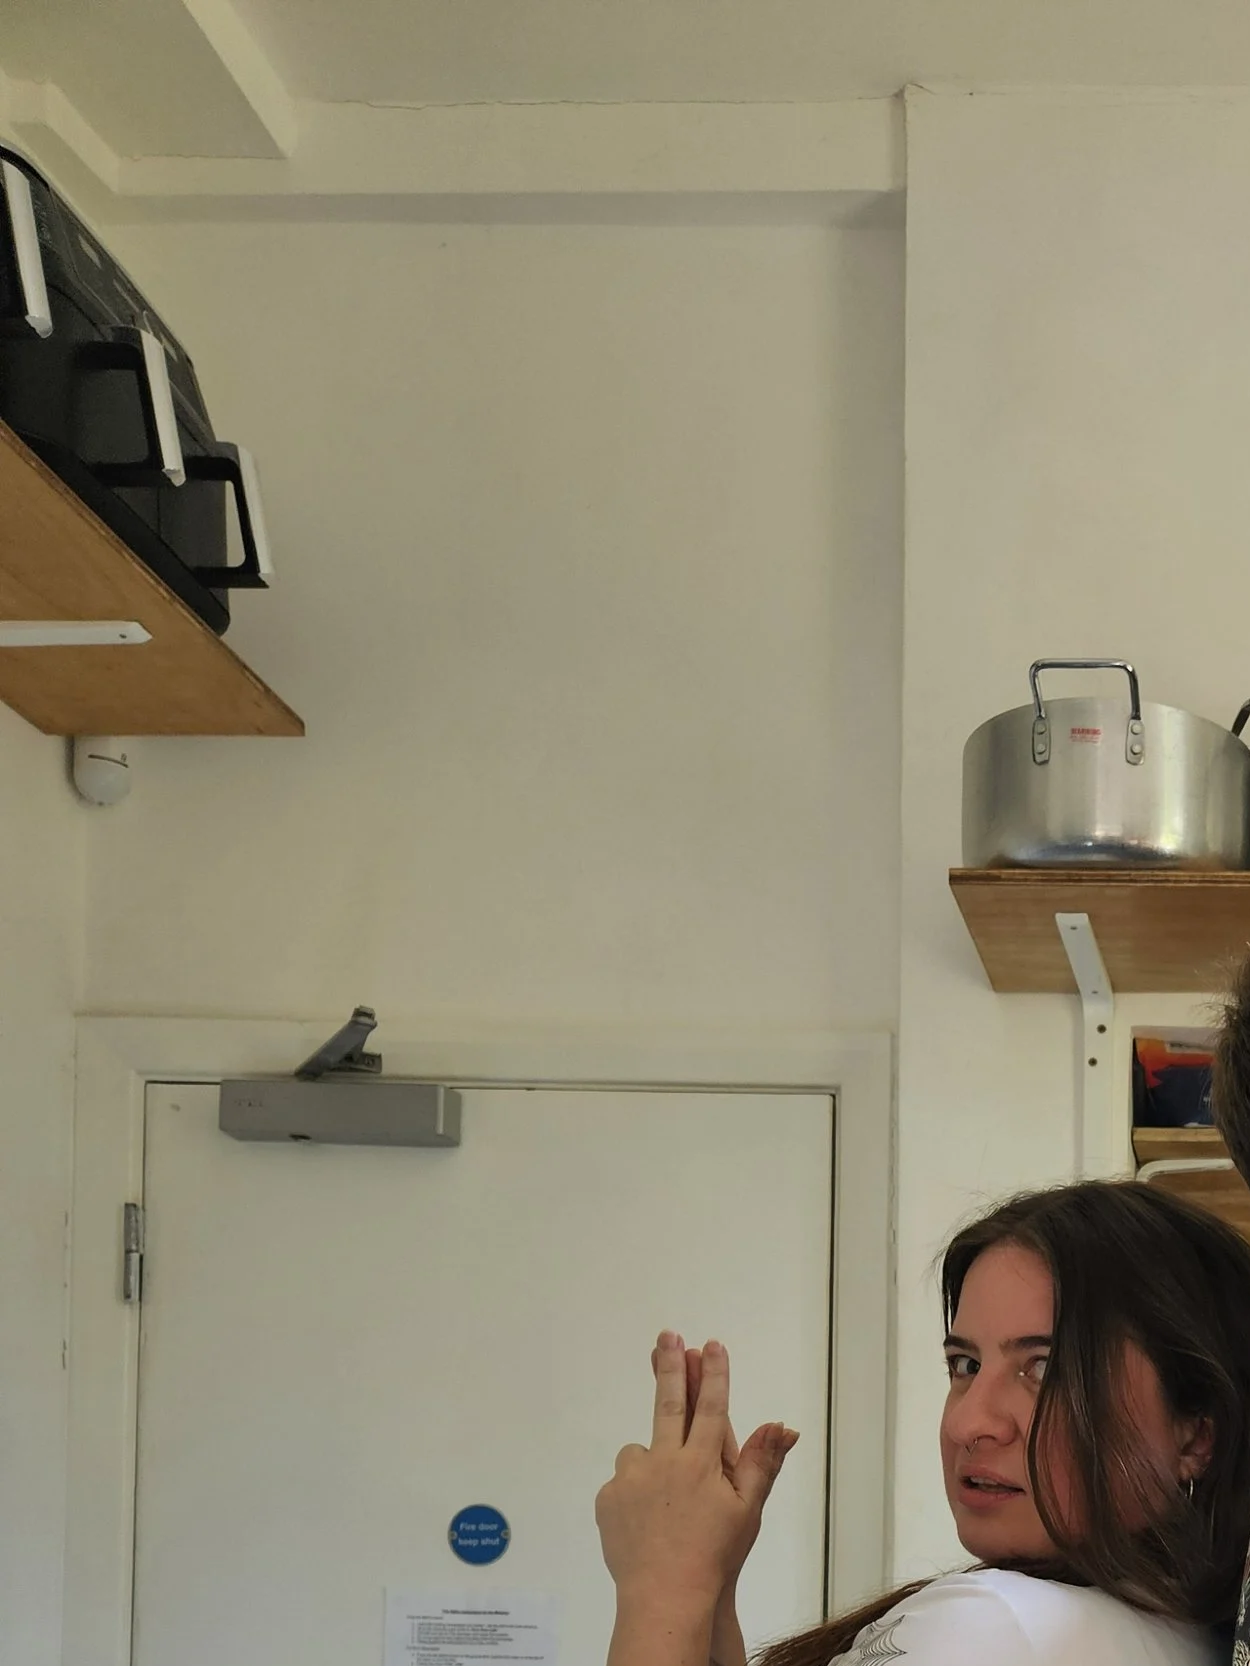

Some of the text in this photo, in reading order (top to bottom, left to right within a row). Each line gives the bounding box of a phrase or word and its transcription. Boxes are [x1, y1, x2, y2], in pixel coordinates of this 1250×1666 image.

[460, 1522, 498, 1531] Fire door
[458, 1537, 500, 1548] keep shut
